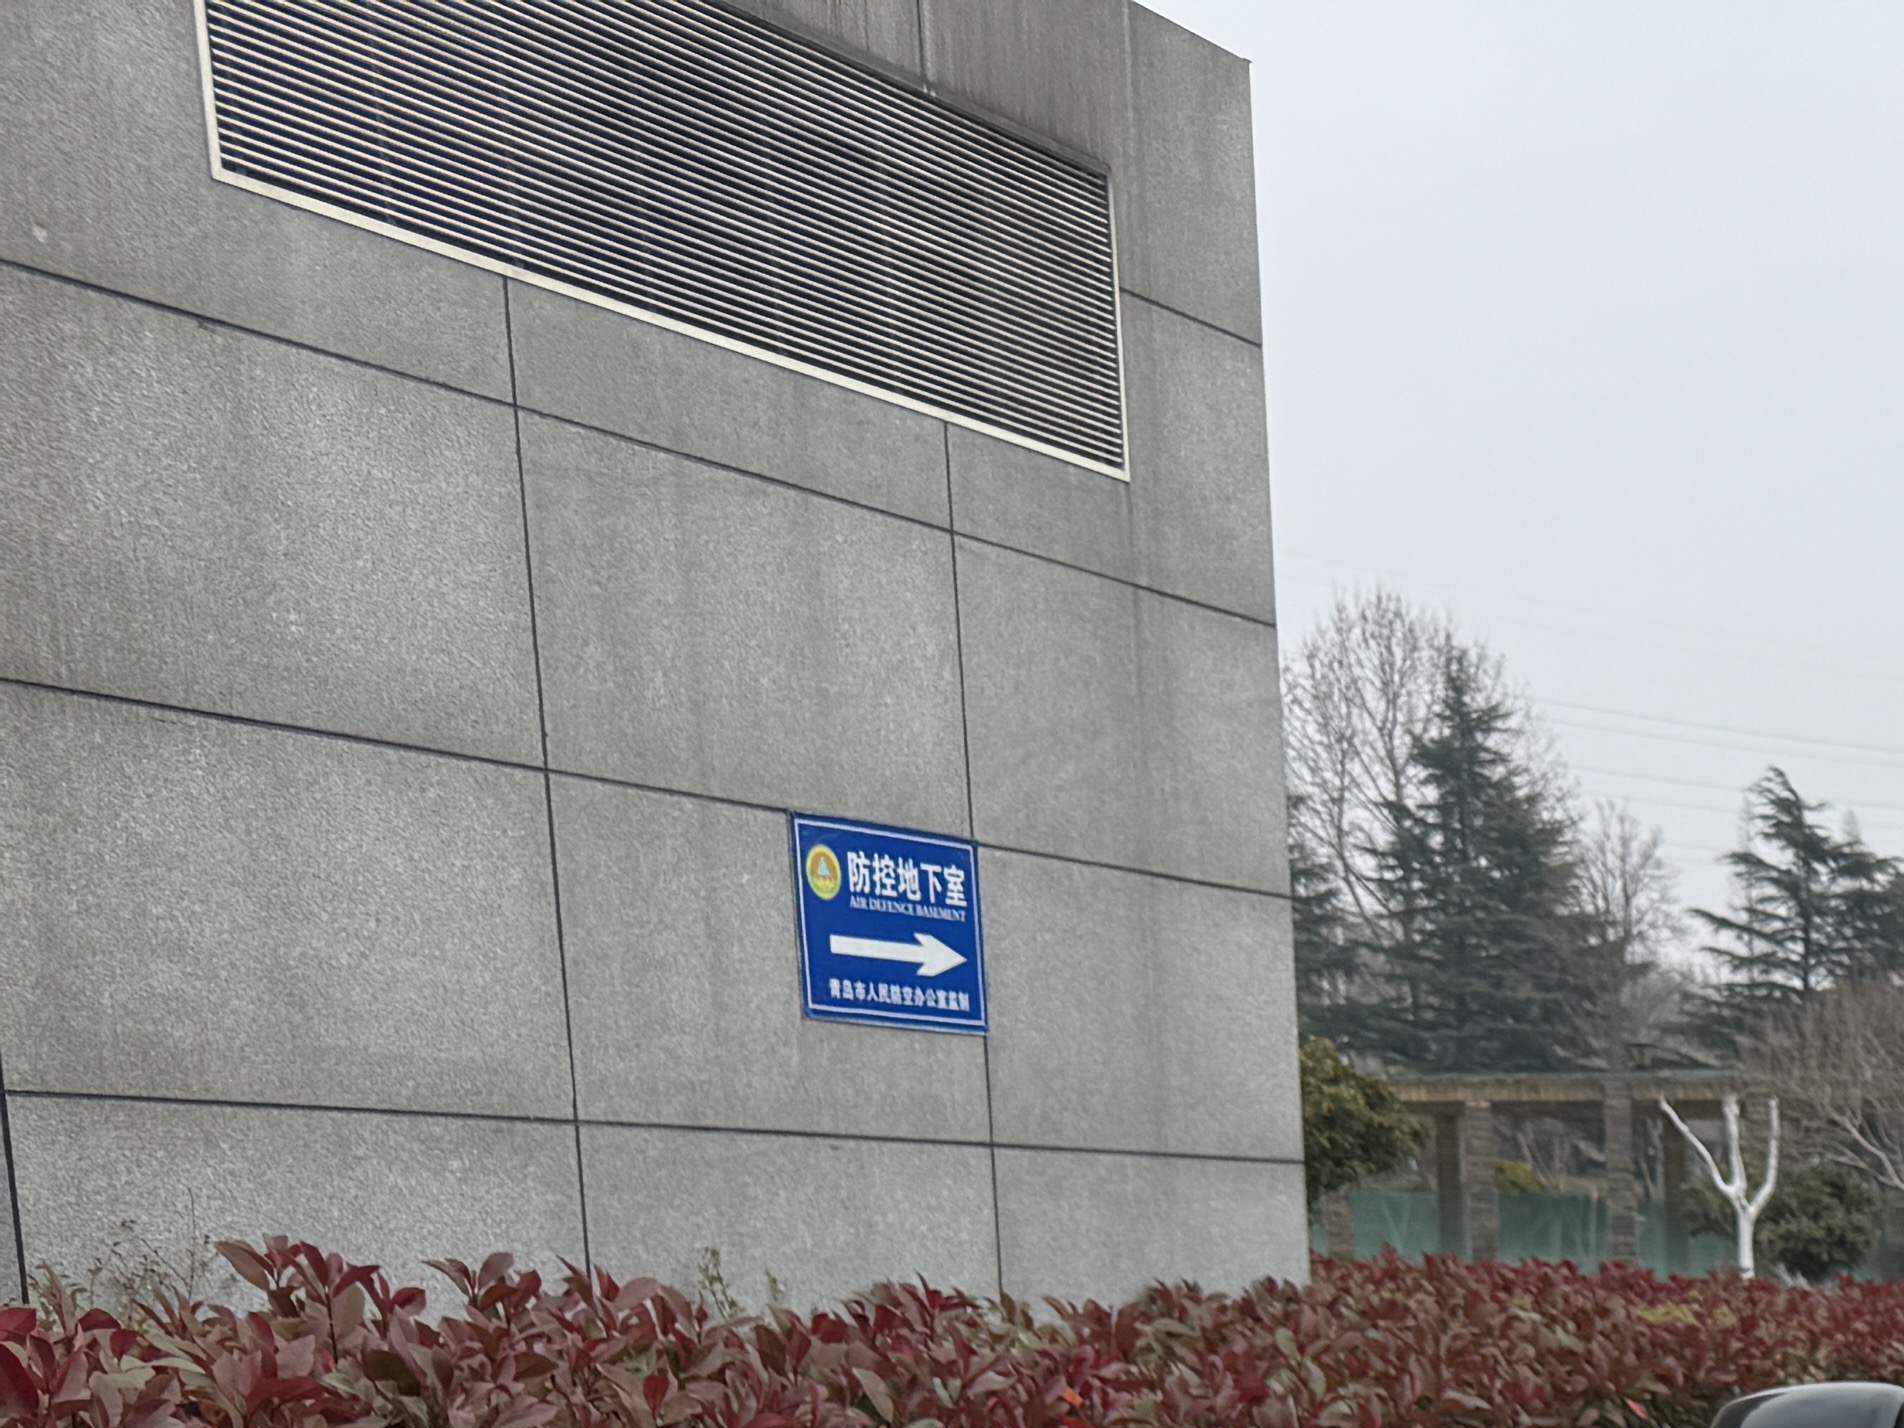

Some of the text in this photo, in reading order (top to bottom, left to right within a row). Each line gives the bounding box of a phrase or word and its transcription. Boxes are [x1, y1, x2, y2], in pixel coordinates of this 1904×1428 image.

[847, 850, 967, 907] 防控地下室
[850, 895, 868, 910] AIR
